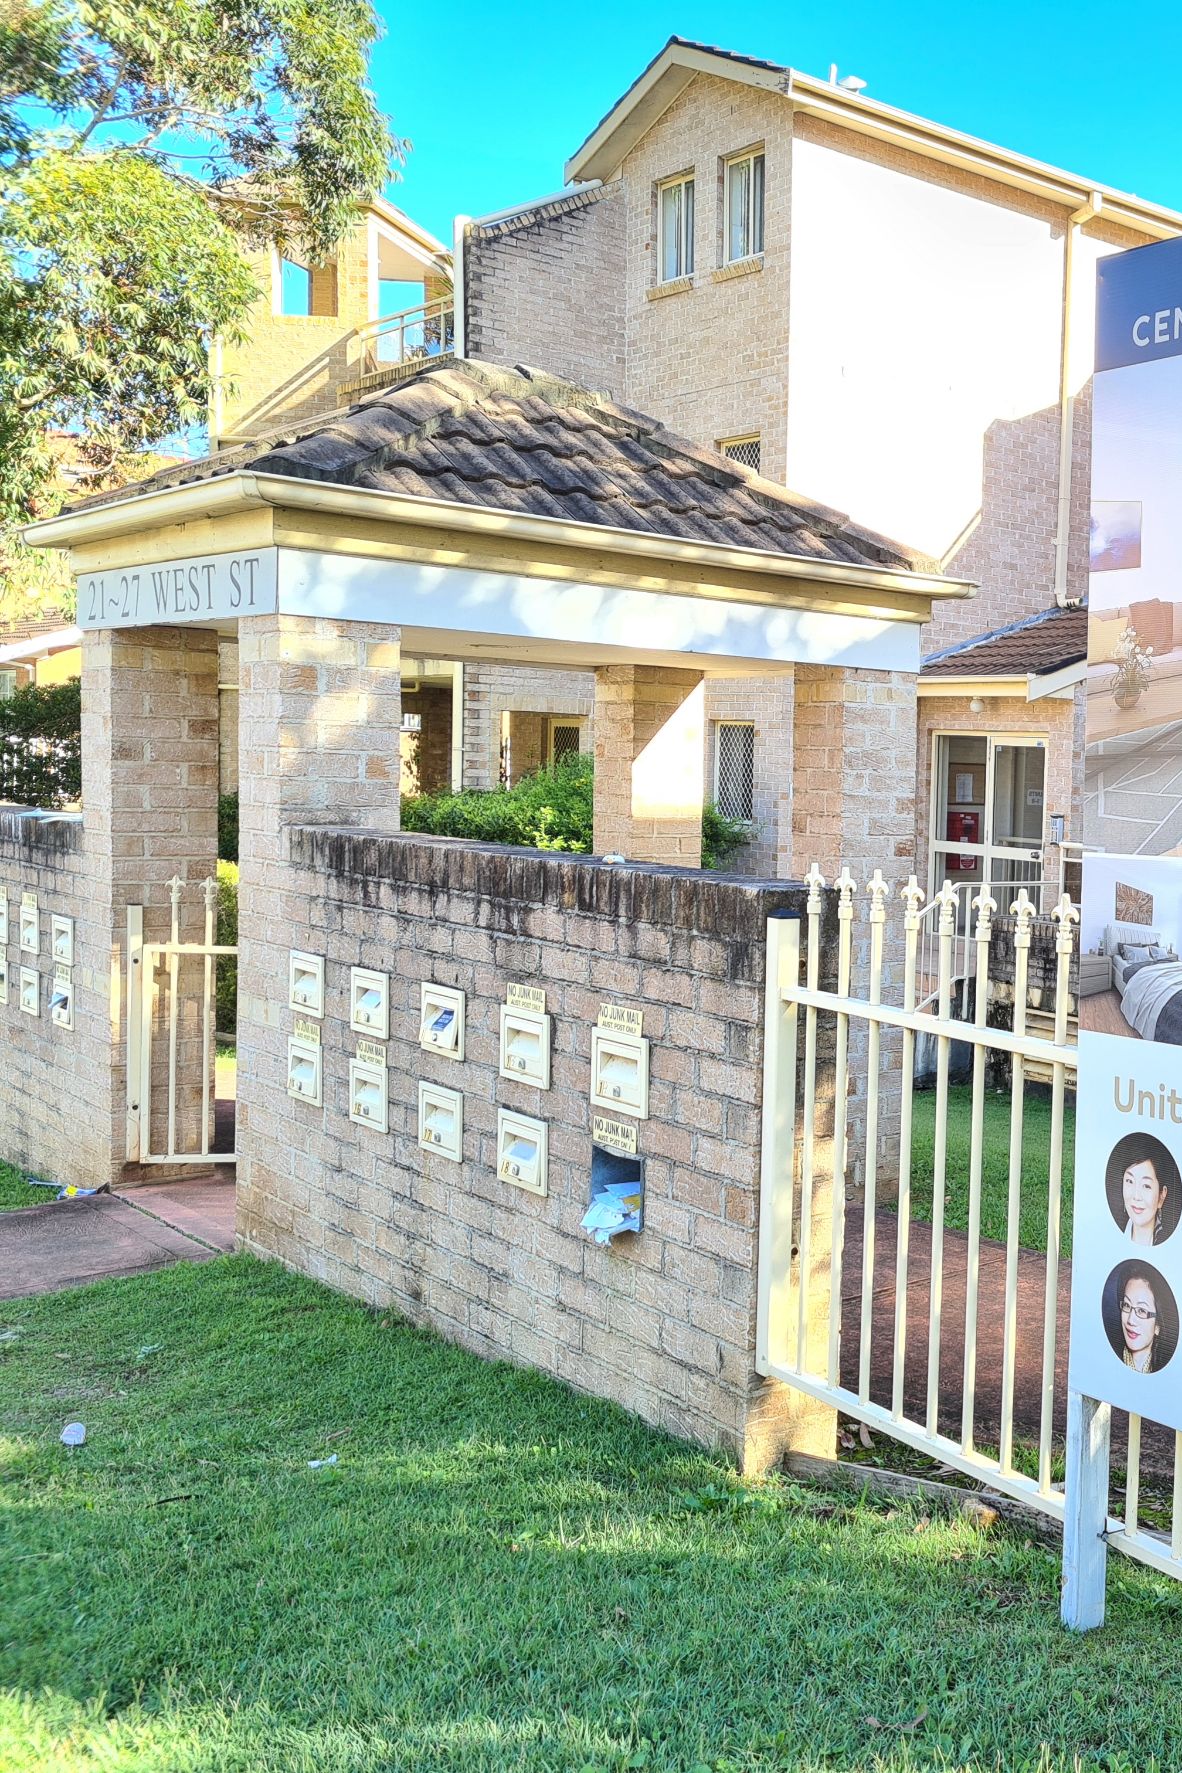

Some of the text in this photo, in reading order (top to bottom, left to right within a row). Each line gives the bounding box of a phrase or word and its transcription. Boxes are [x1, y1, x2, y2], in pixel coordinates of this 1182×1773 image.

[151, 564, 216, 615] WEST
[229, 558, 260, 608] ST
[508, 984, 516, 997] NO
[518, 986, 531, 1000] JUNK
[600, 1005, 640, 1025] NO JUNK MAIL
[614, 1023, 625, 1031] POST
[1114, 1076, 1182, 1124] Unit
[594, 1117, 604, 1131] NO
[605, 1121, 620, 1138] JUNK
